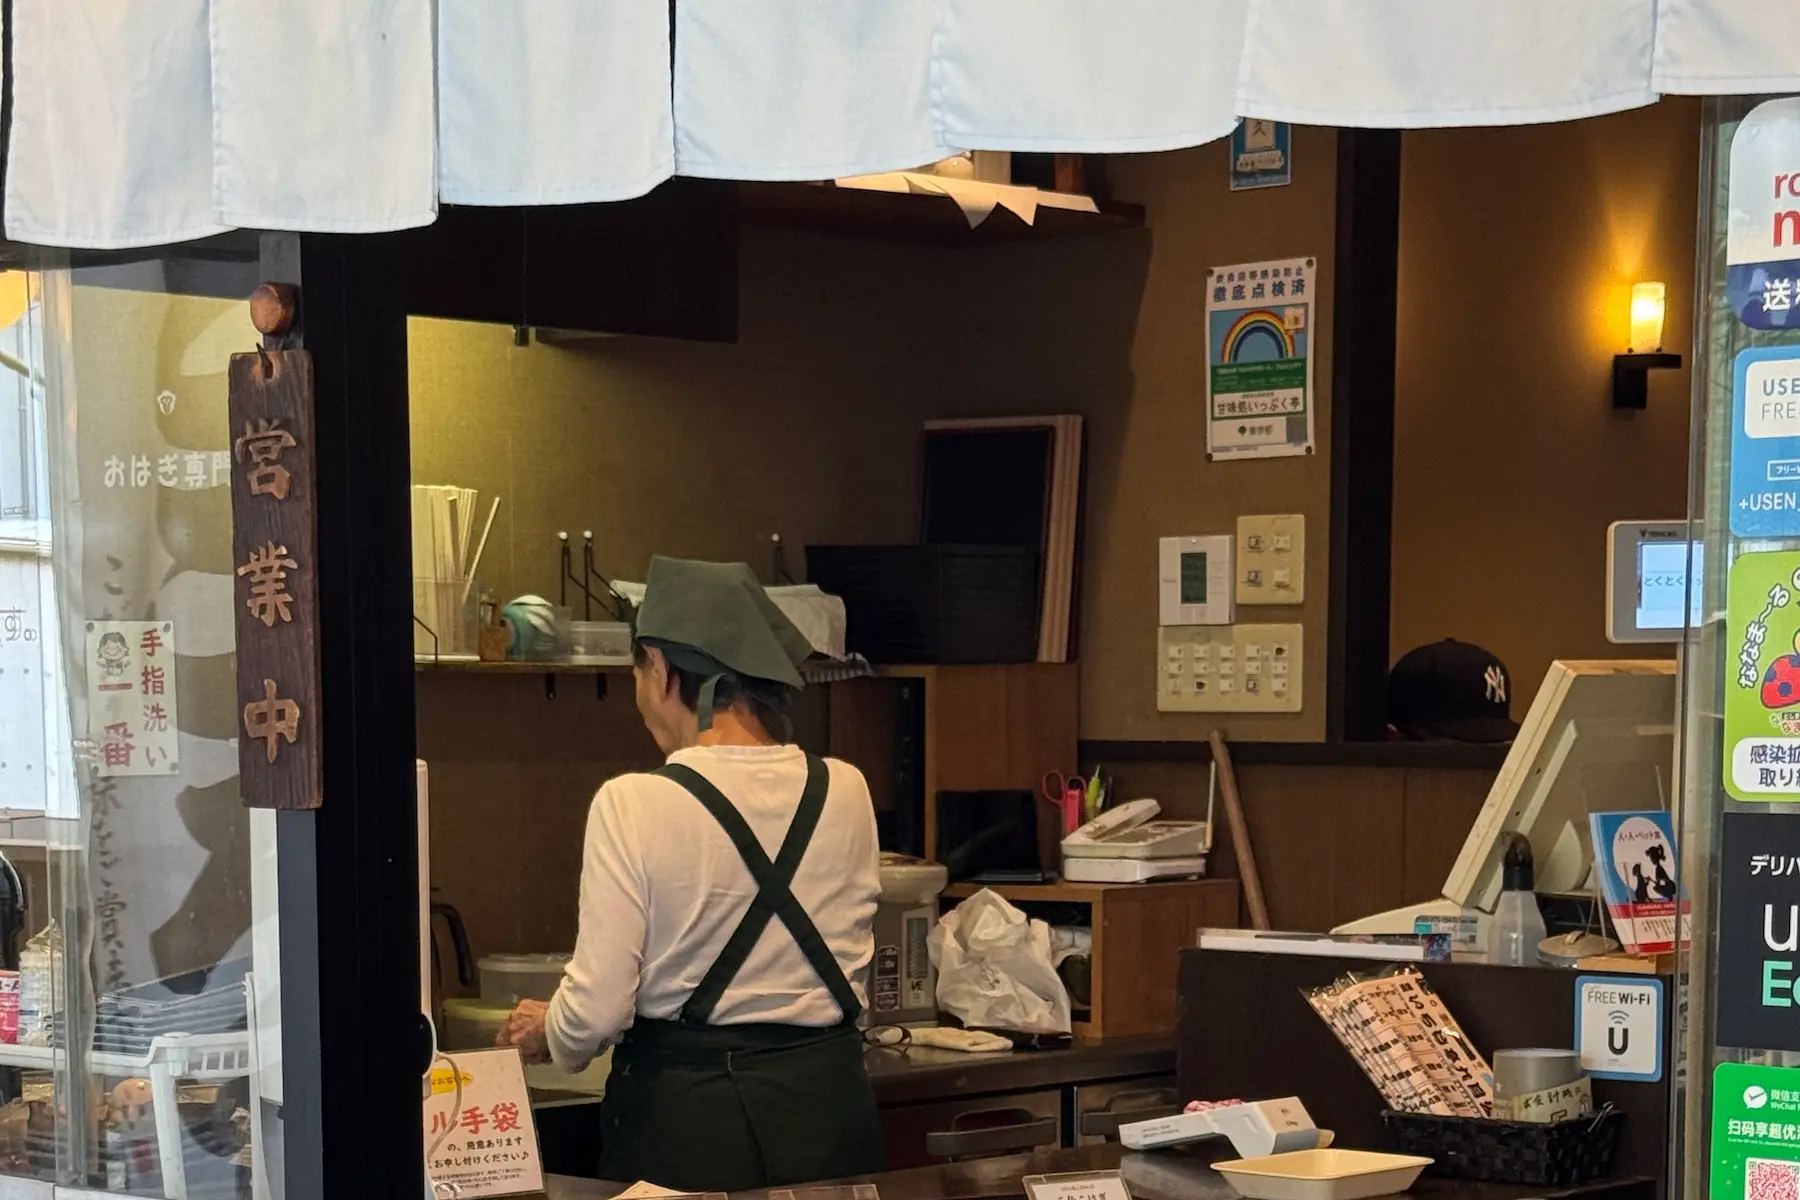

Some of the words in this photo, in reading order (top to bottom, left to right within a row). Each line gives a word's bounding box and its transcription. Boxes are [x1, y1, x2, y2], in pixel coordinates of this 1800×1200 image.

[1763, 278, 1800, 312] 送
[1762, 402, 1800, 420] FRE
[235, 420, 300, 764] 営業中
[140, 627, 168, 768] 手指洗い
[97, 682, 136, 768] 一番
[1759, 768, 1800, 787] 取り
[1587, 991, 1617, 1004] FREE
[1762, 960, 1800, 1008] E
[1728, 1118, 1800, 1140] 扫码享超优
